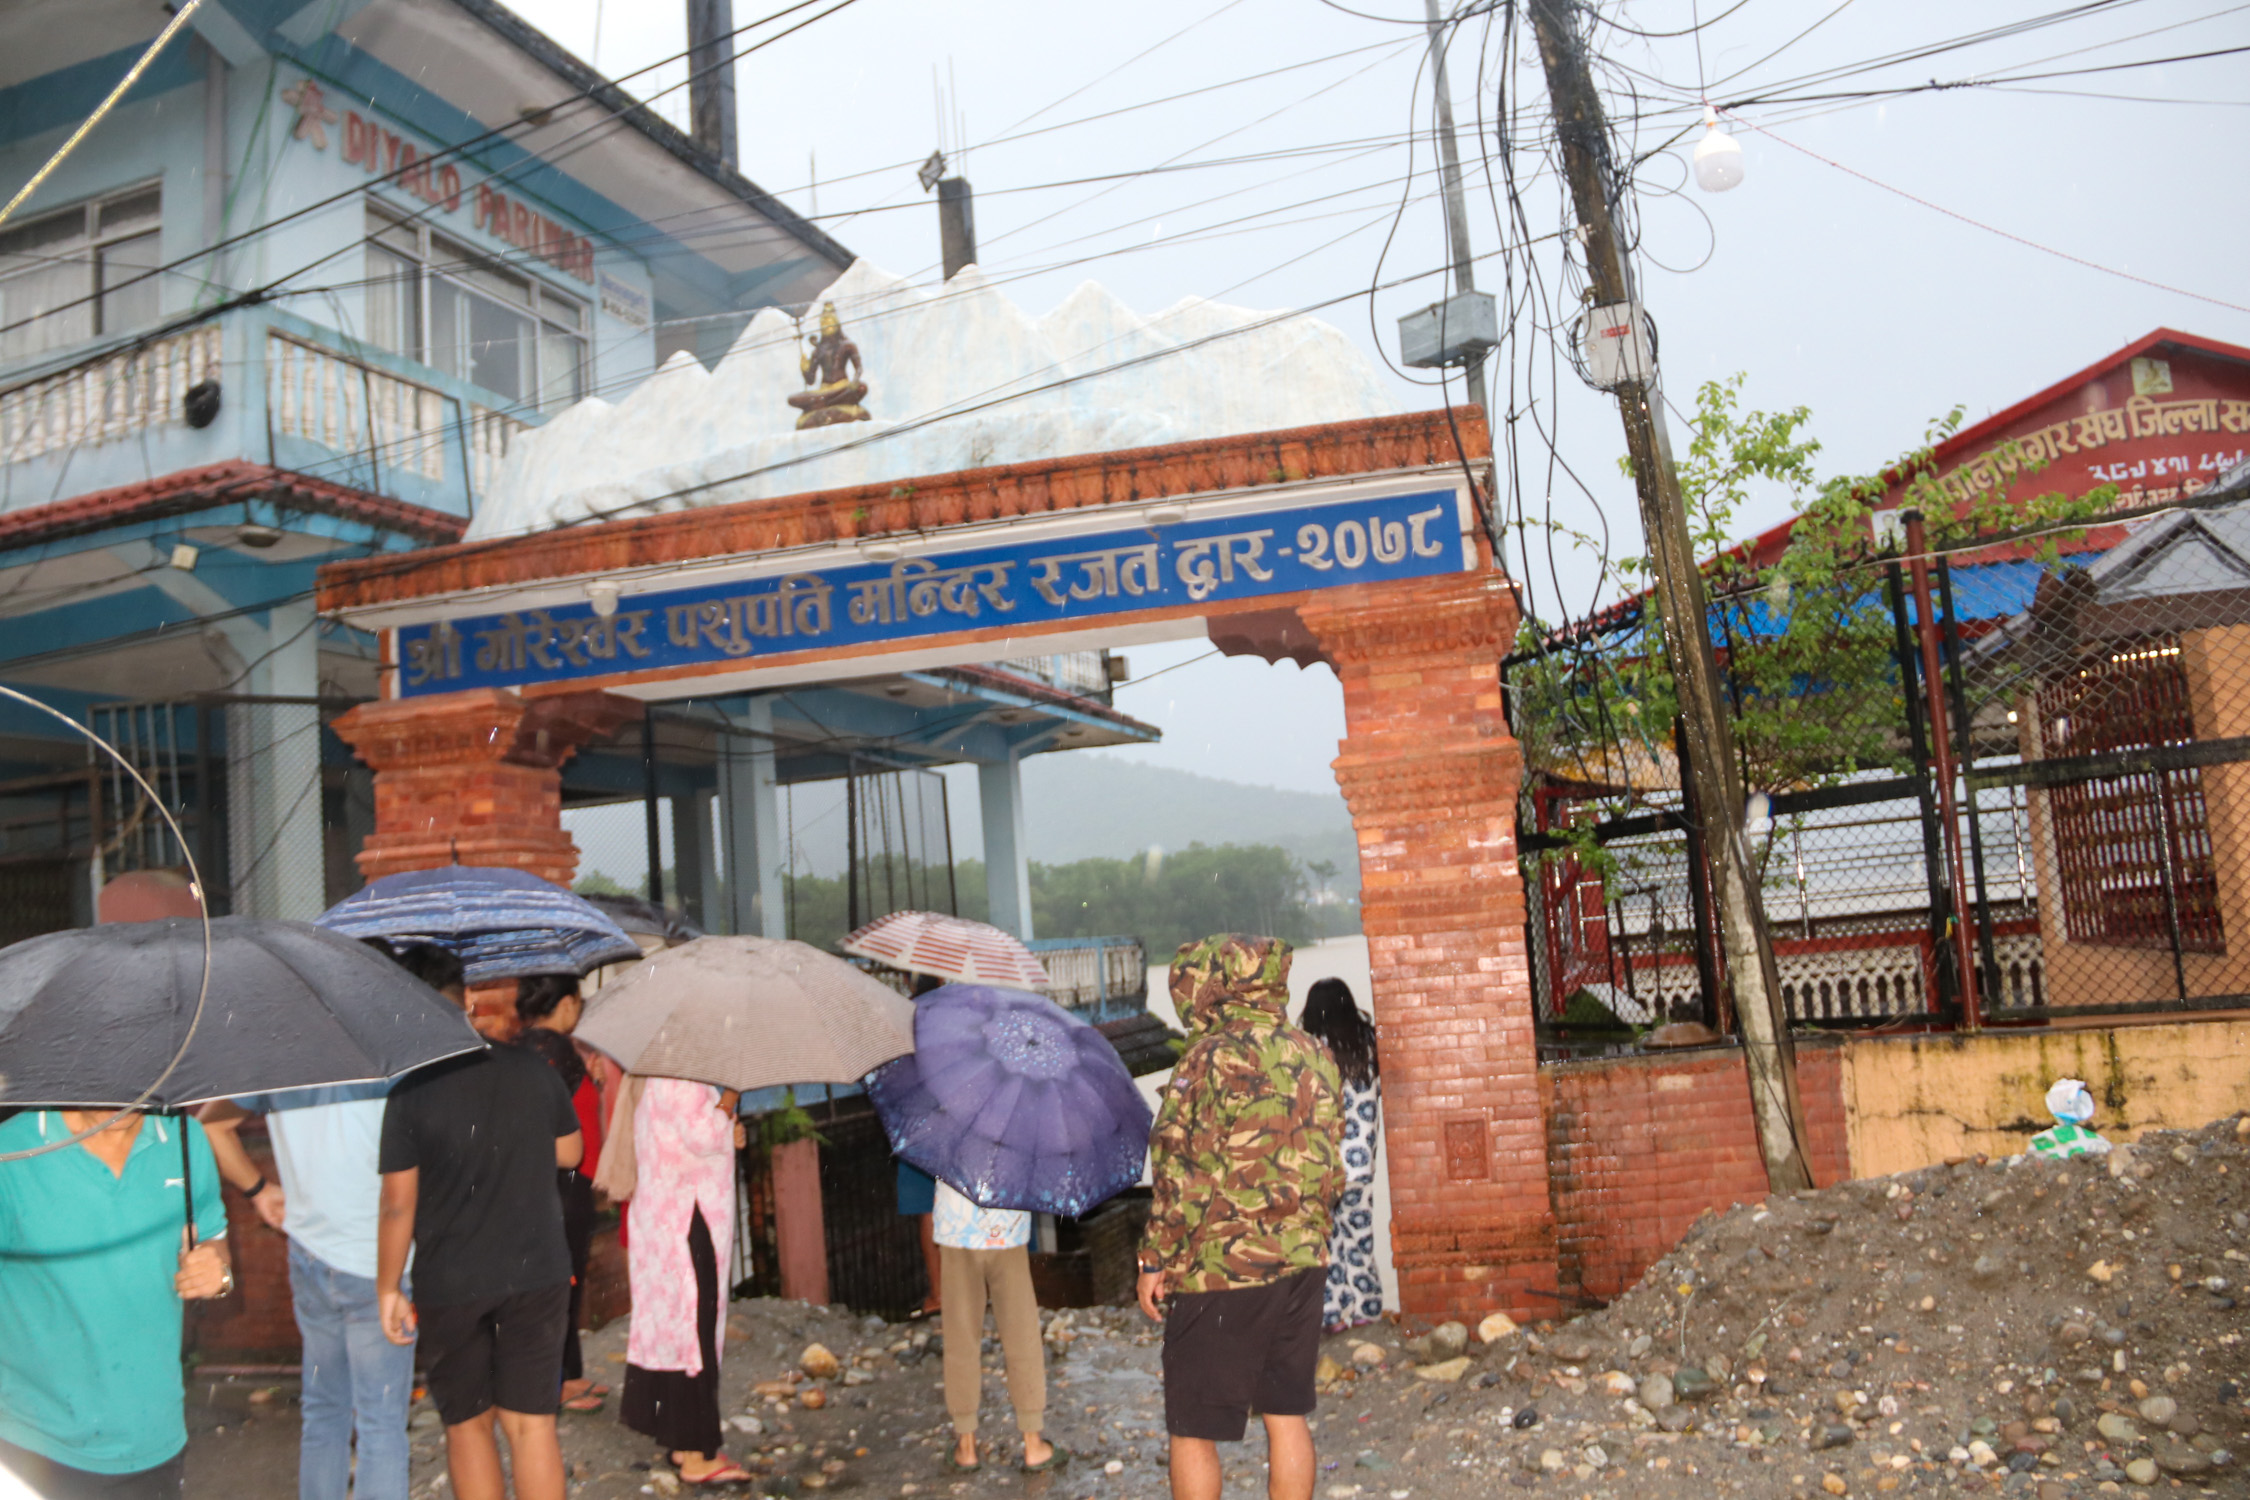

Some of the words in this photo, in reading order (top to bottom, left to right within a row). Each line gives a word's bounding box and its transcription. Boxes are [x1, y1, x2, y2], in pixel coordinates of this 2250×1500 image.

[341, 110, 461, 214] DIYALO
[474, 183, 595, 286] PARIWAR
[2071, 405, 2128, 449] संघ
[2127, 394, 2219, 438] जिल्ला
[405, 616, 463, 686] श्री
[664, 573, 834, 656] पशुपति
[846, 557, 1018, 627] मन्दिर
[1028, 542, 1161, 606] रजत
